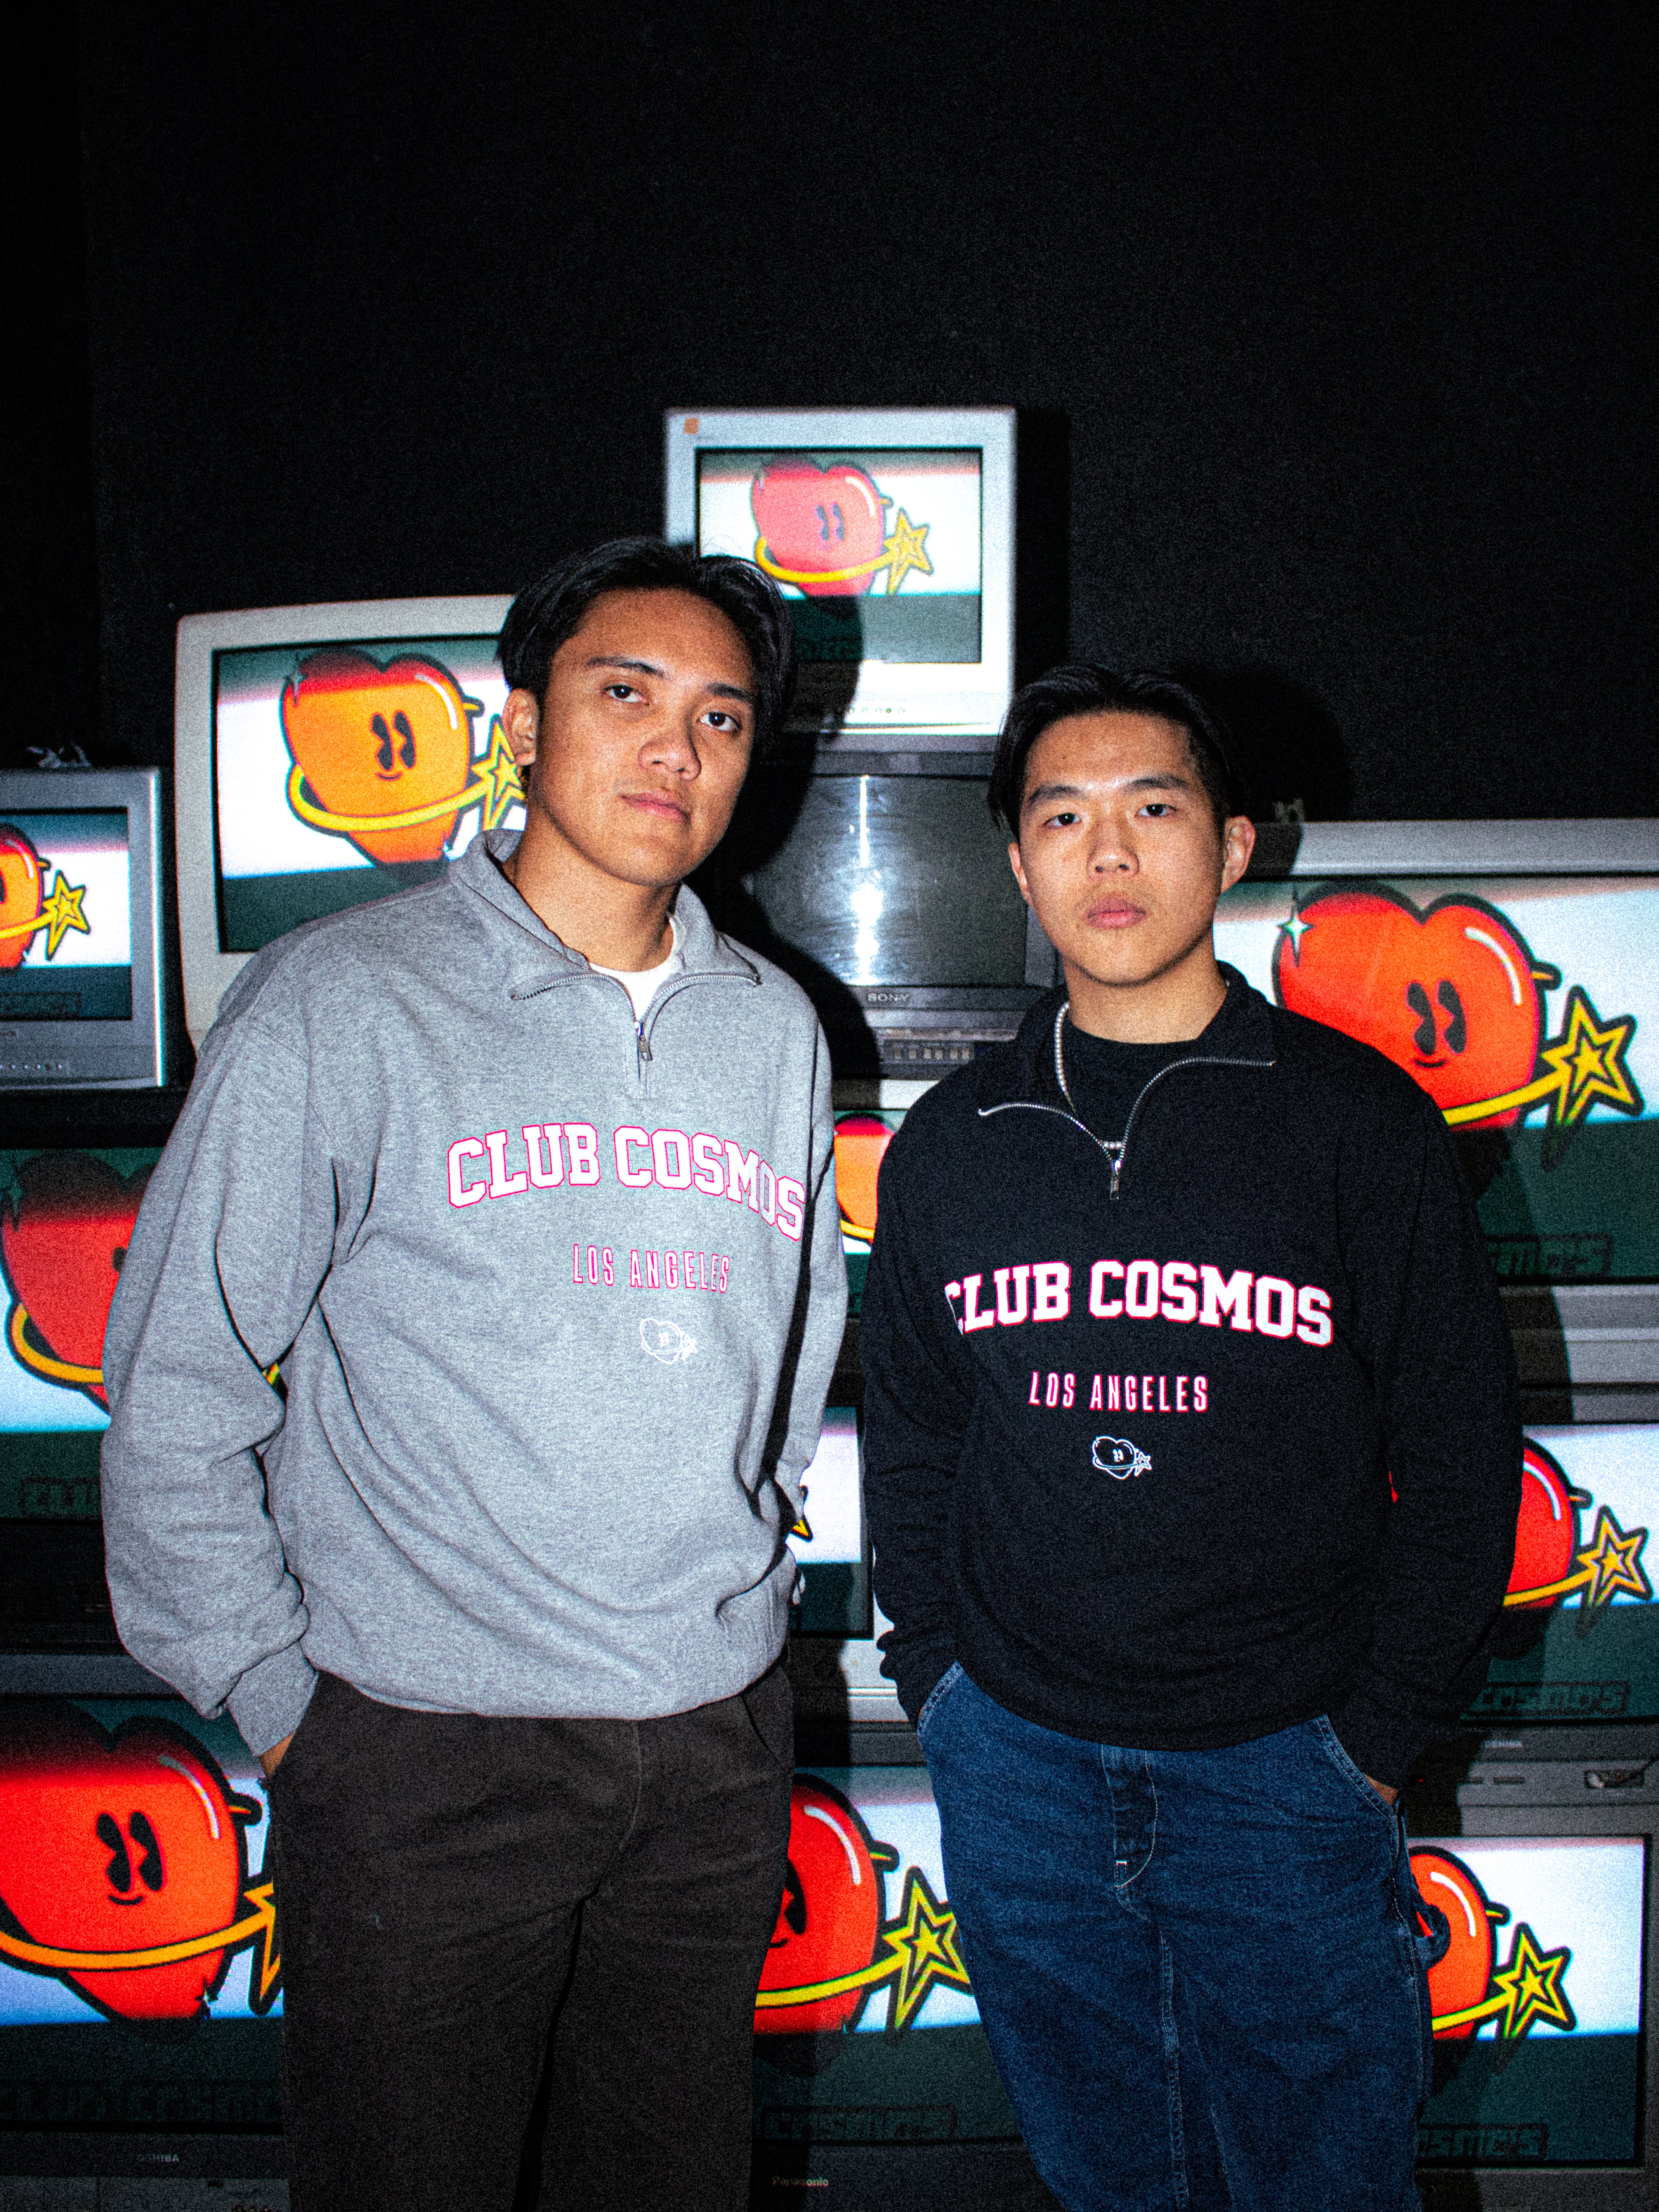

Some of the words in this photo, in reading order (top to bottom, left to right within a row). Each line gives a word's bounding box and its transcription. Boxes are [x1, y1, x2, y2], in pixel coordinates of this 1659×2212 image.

[868, 993, 909, 1002] SONY
[447, 1122, 601, 1209] CLUB
[614, 1125, 806, 1241] COSMOS
[573, 1243, 615, 1286] LOS
[630, 1249, 731, 1293] ANGELES
[1089, 1259, 1333, 1348] COSMOS
[1028, 1372, 1076, 1409] LOS
[1089, 1375, 1209, 1413] ANGELES
